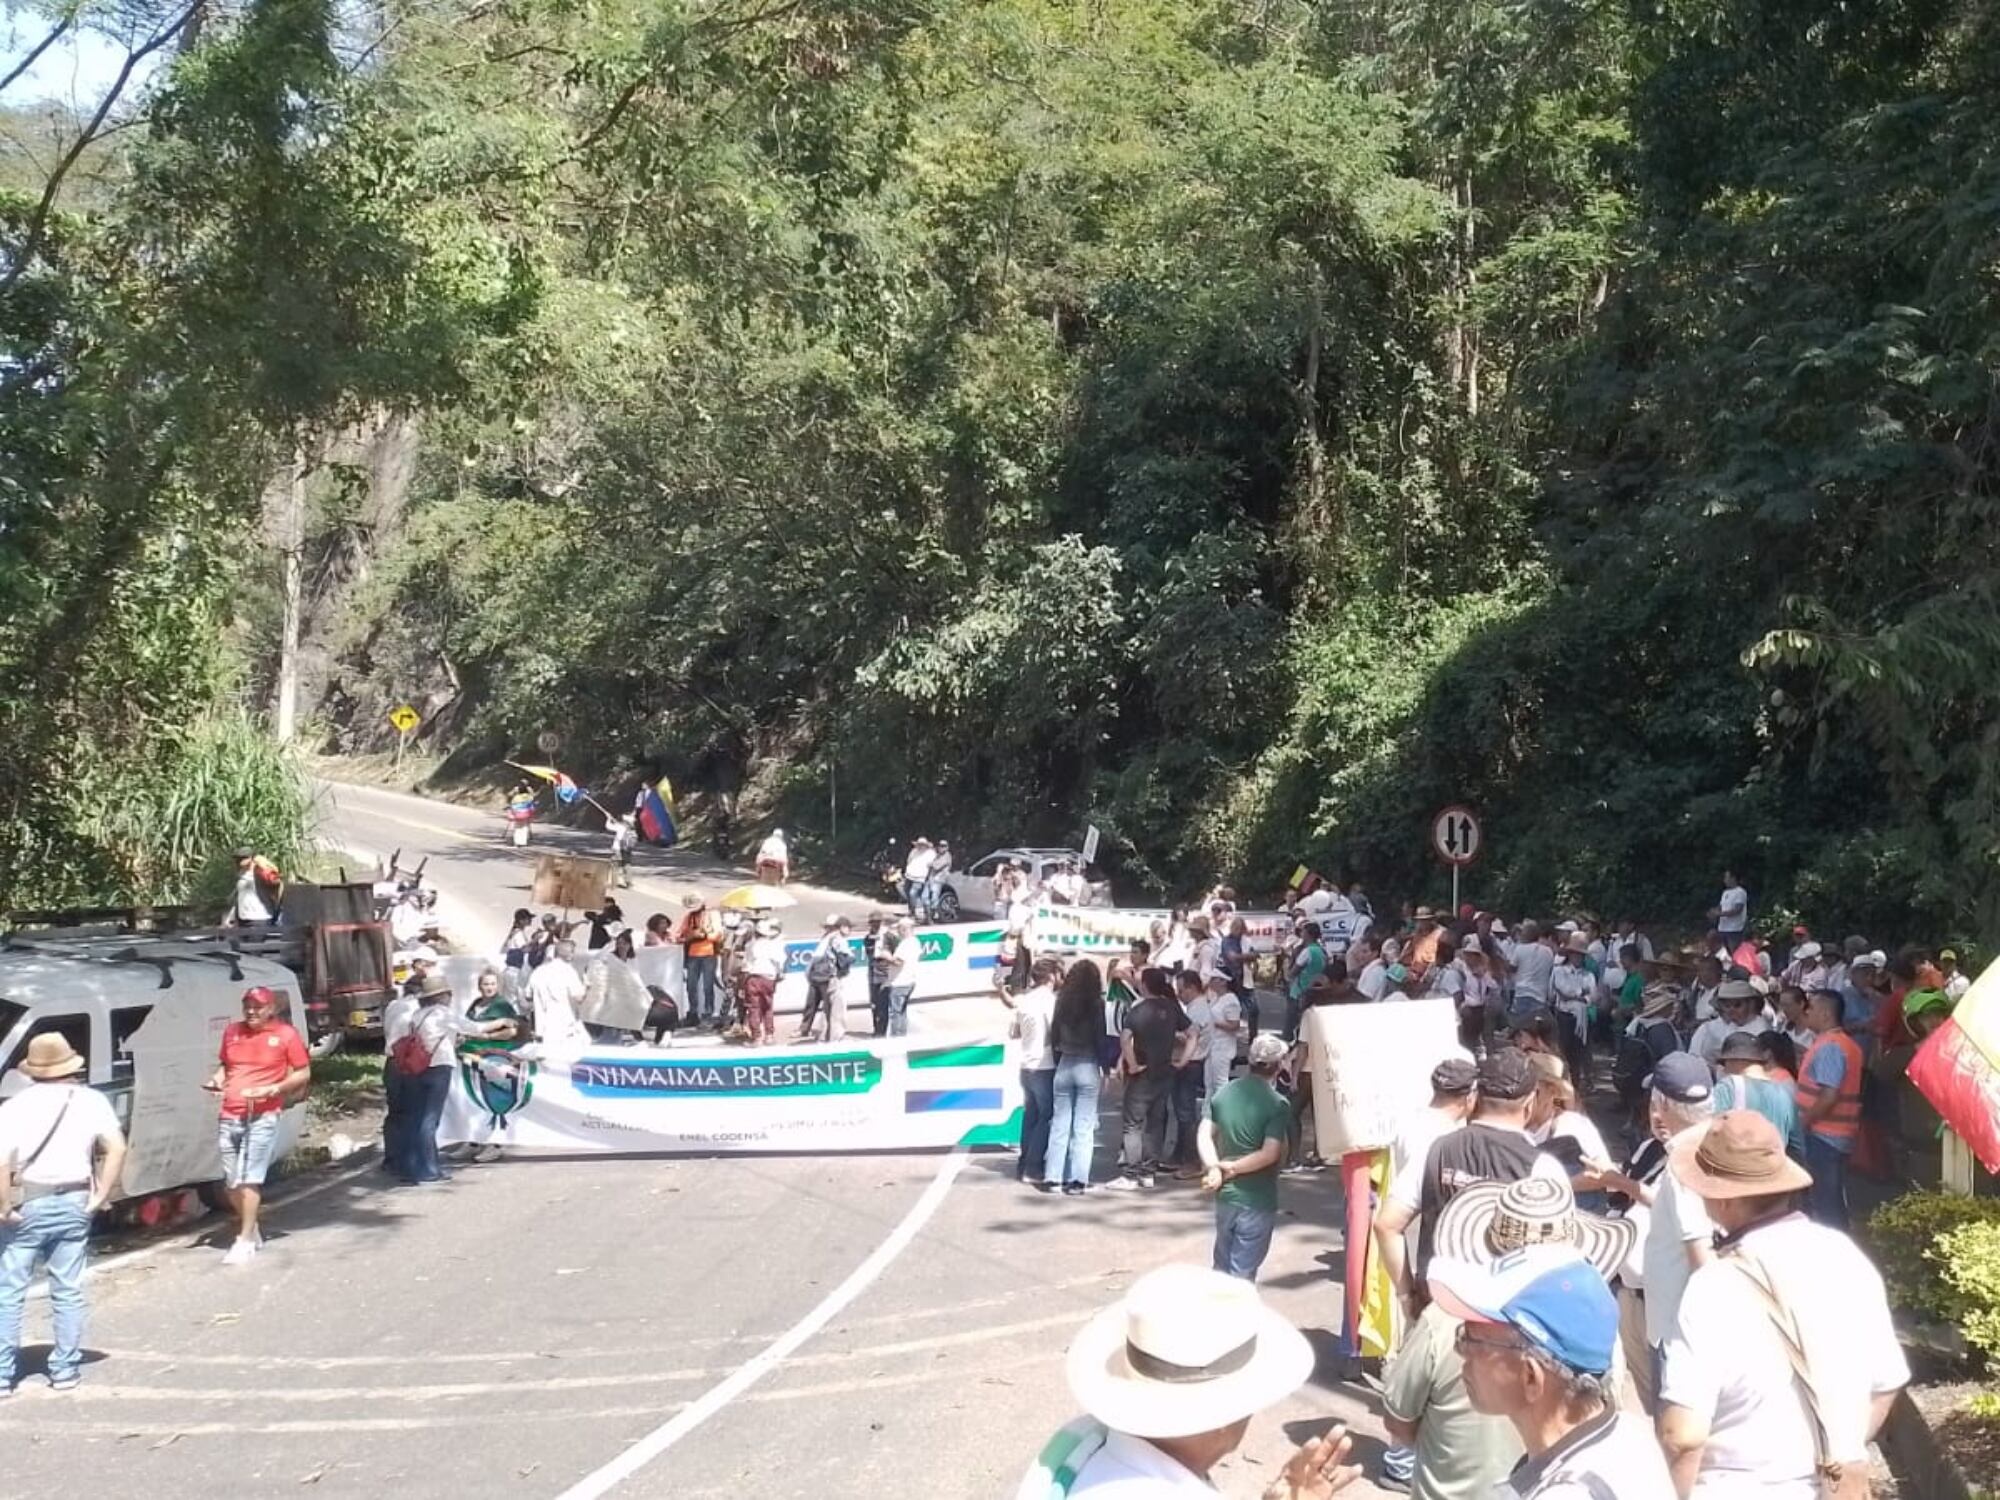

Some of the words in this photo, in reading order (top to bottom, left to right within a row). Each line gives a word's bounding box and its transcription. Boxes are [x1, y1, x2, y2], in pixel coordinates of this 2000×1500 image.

[586, 1066, 725, 1088] NIMAIMA
[733, 1060, 867, 1087] PRESENTE
[712, 1132, 769, 1143] CODENSA
